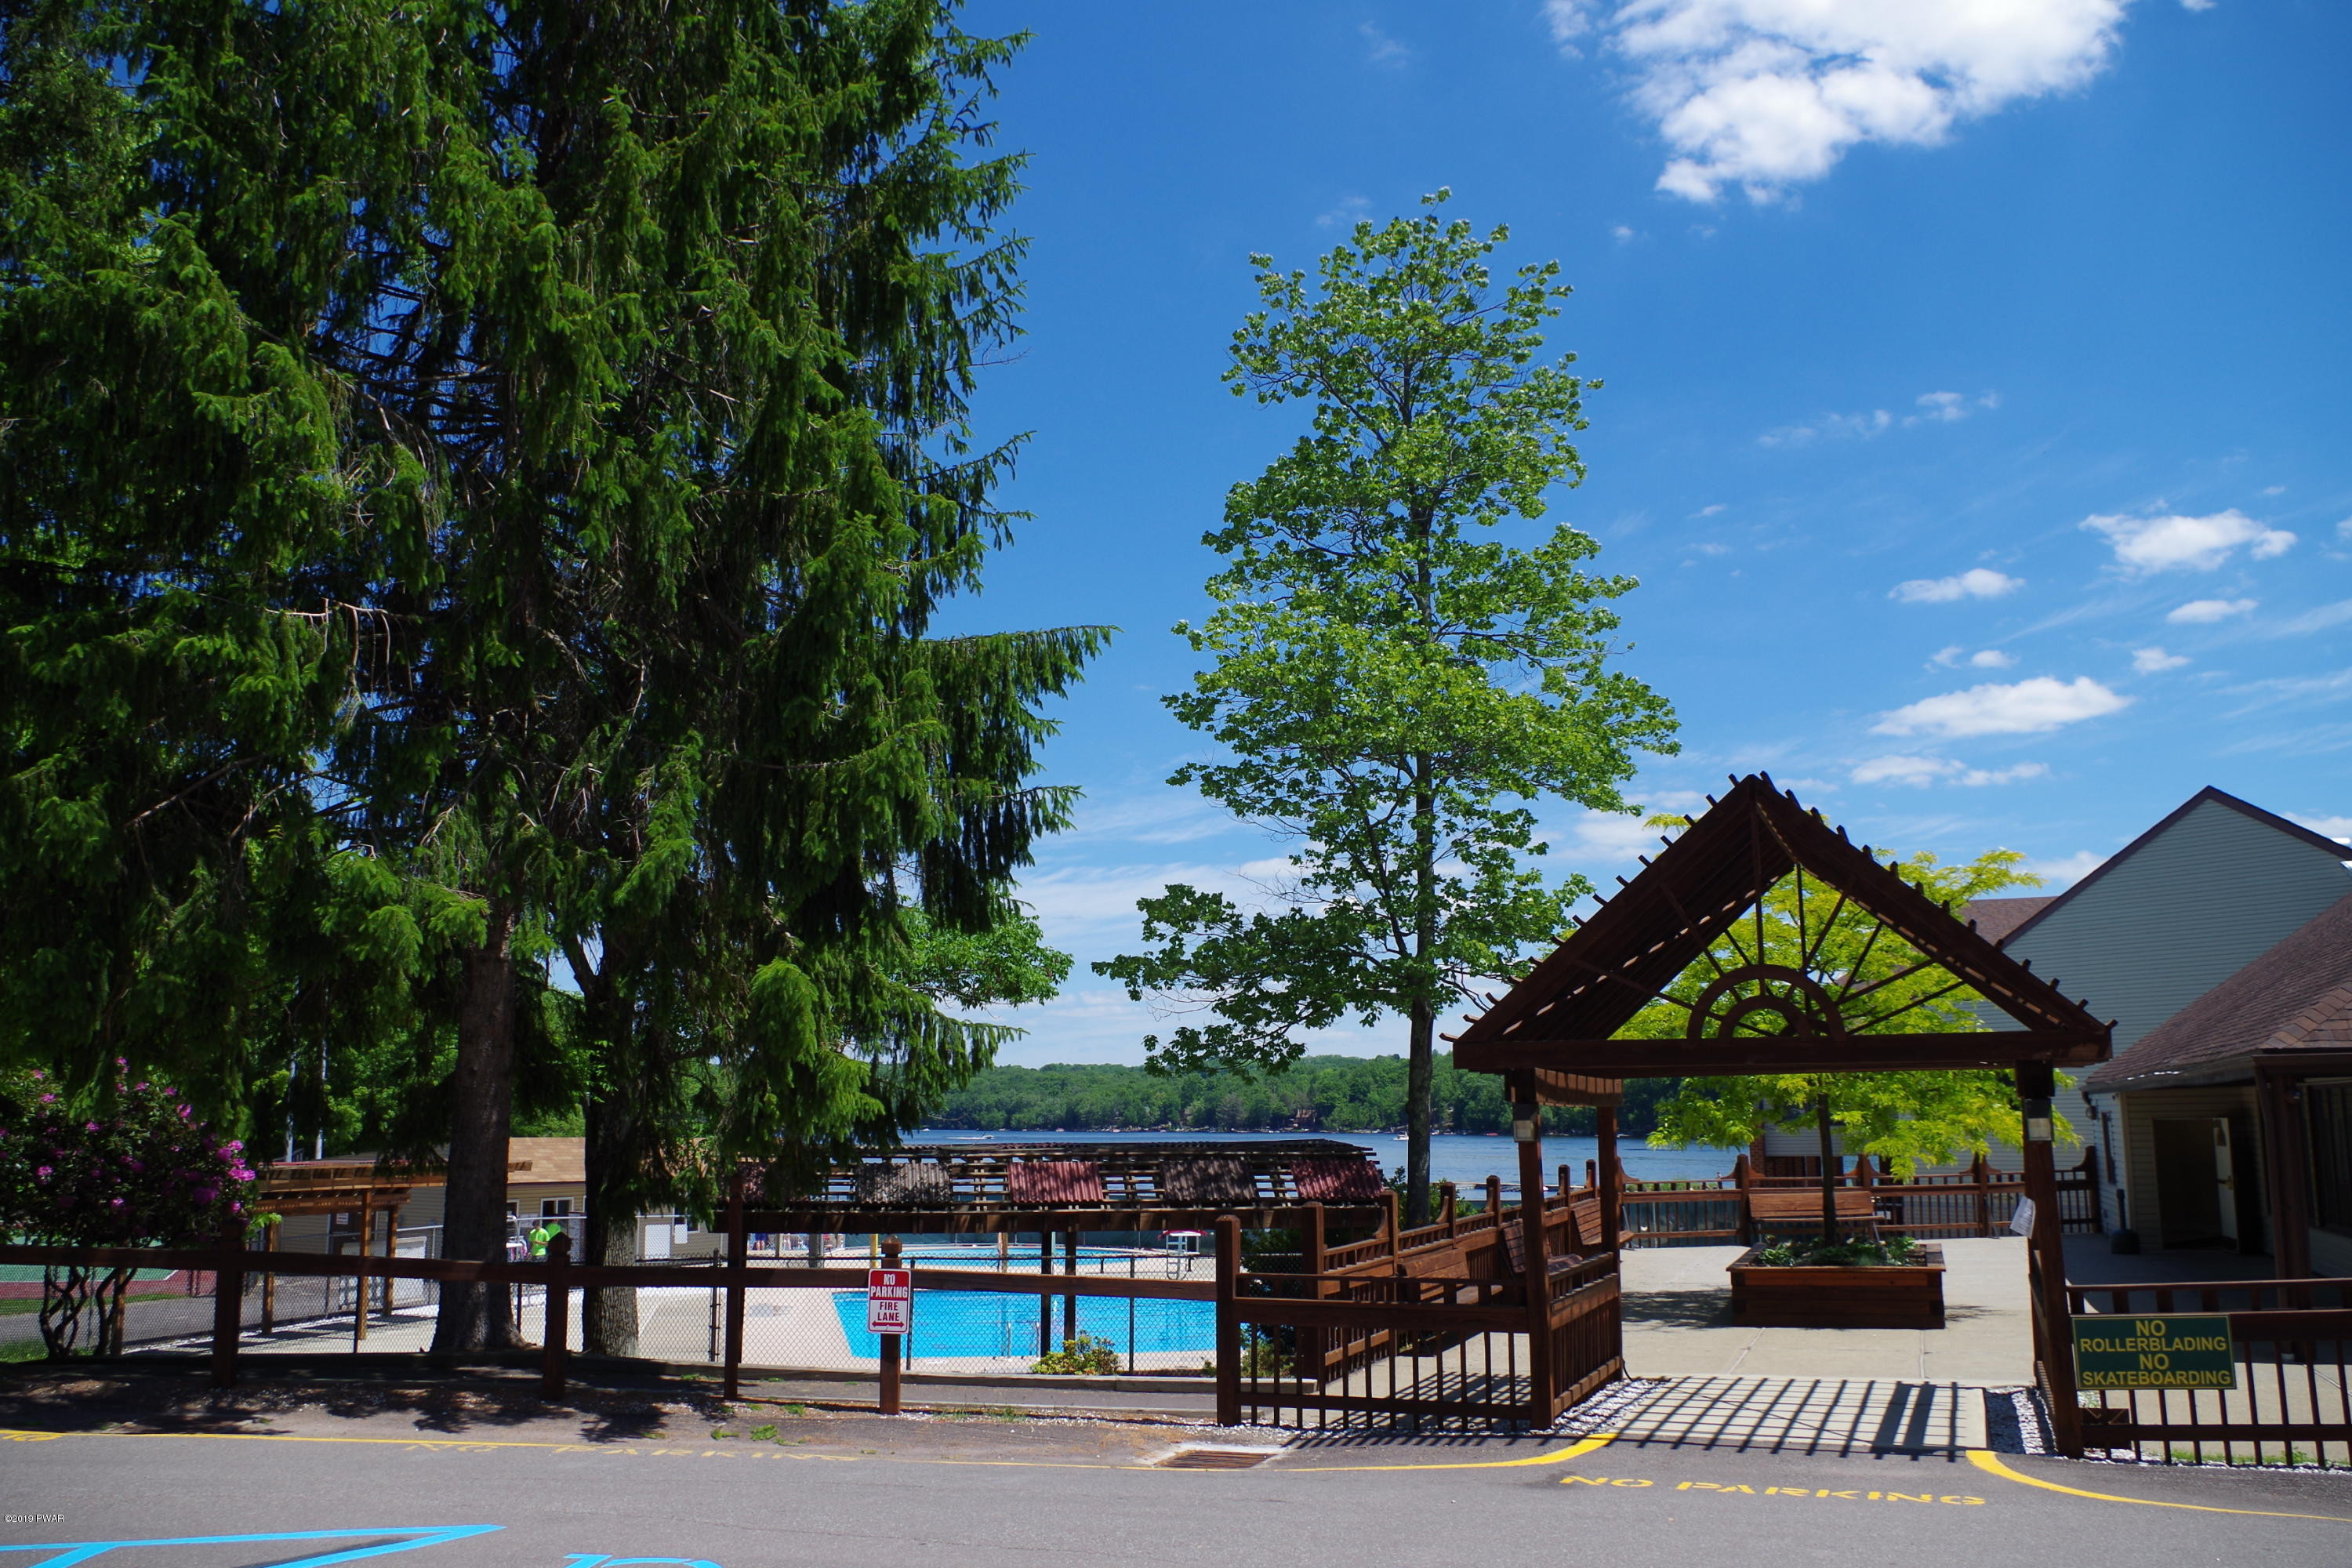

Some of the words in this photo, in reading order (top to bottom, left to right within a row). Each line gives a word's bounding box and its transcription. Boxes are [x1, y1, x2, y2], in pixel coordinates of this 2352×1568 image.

[884, 1273, 895, 1285] NO
[870, 1286, 908, 1298] PARKING
[880, 1301, 898, 1311] FIRE
[877, 1312, 899, 1321] LANE
[2136, 1320, 2166, 1336] NO
[2080, 1337, 2227, 1352] ROLLERBLADING
[2139, 1353, 2169, 1370] NO
[2082, 1370, 2231, 1385] SKATEBOARDING
[403, 1443, 498, 1453] NO
[552, 1446, 859, 1461] PARKING
[1560, 1475, 1653, 1487] NO
[1675, 1481, 1985, 1504] PARKING
